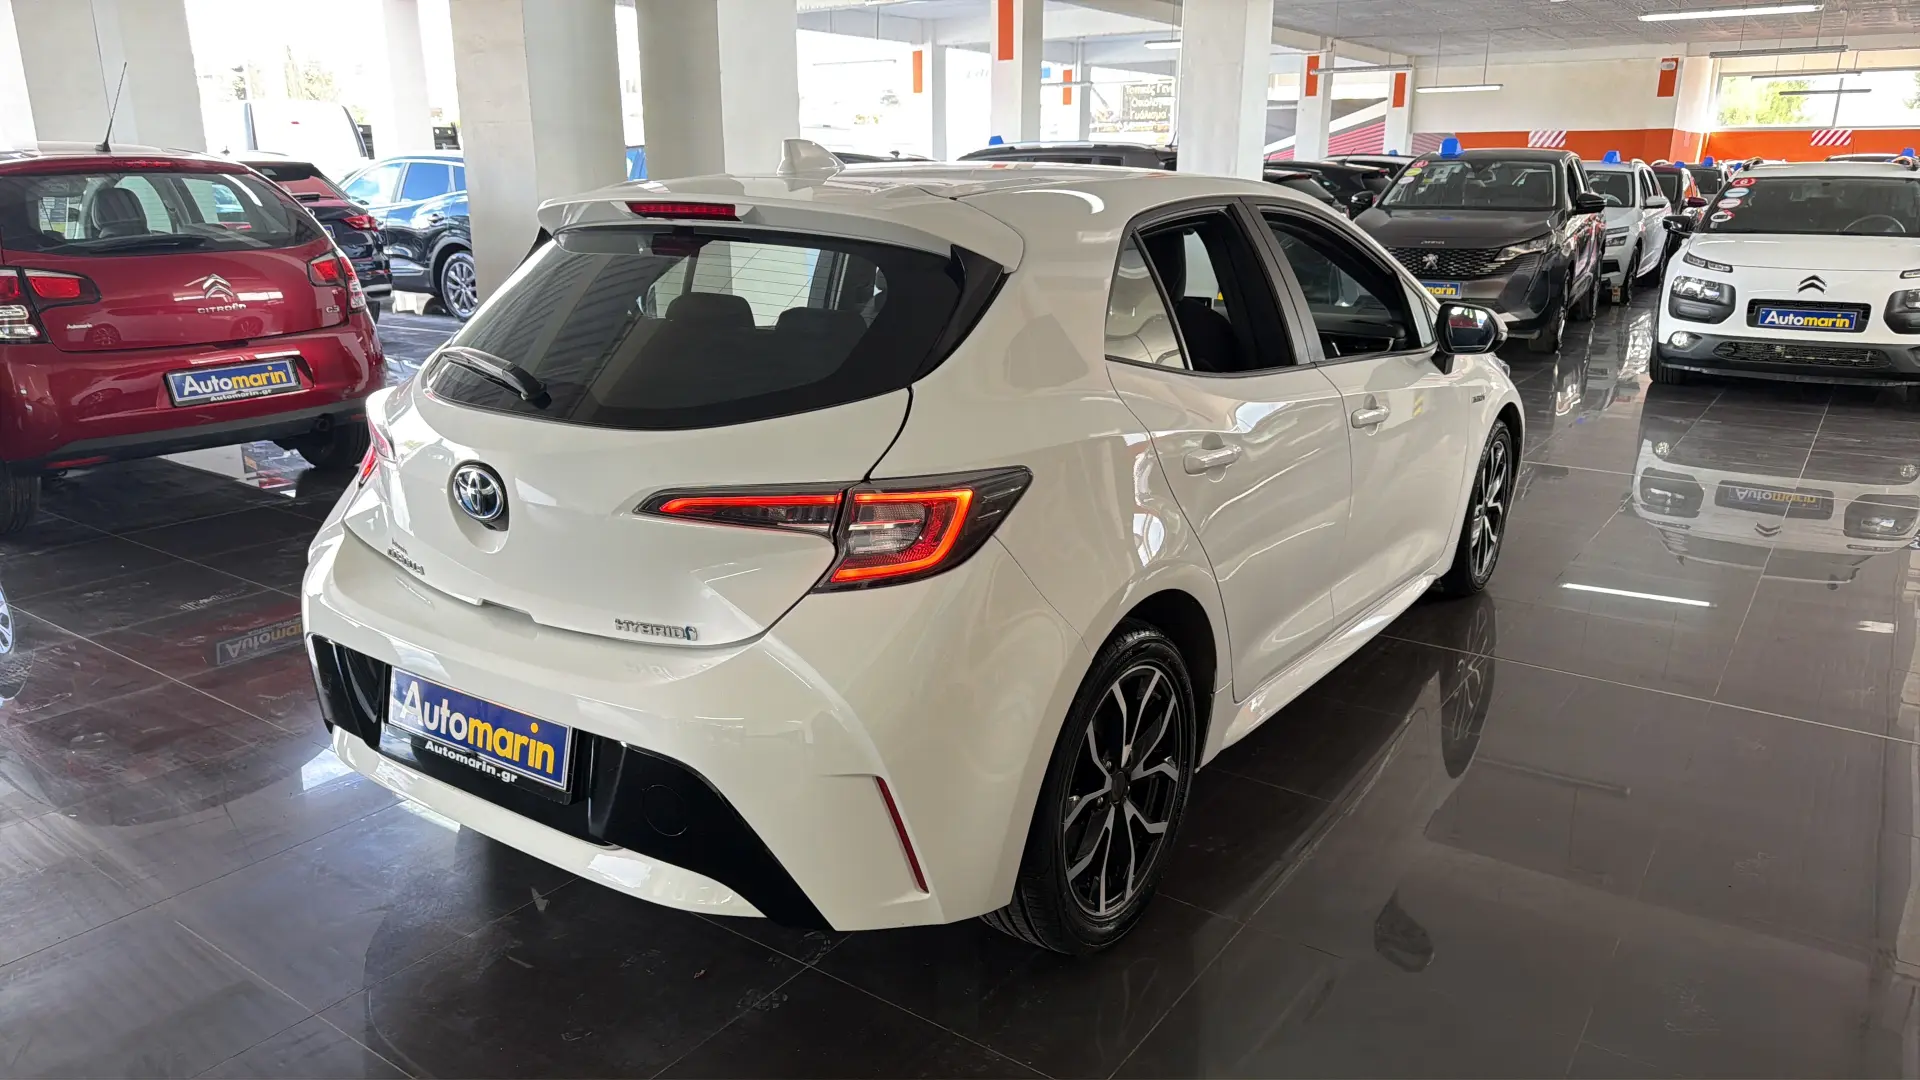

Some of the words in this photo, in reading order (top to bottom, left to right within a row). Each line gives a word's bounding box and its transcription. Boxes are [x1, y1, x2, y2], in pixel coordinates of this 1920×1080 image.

[1763, 310, 1850, 328] Automarin
[183, 366, 288, 396] Automarin
[210, 388, 273, 402] Automarin.gr
[614, 618, 686, 639] HYBRID
[400, 680, 556, 775] Automarin
[425, 741, 518, 783] Automarin.gr
